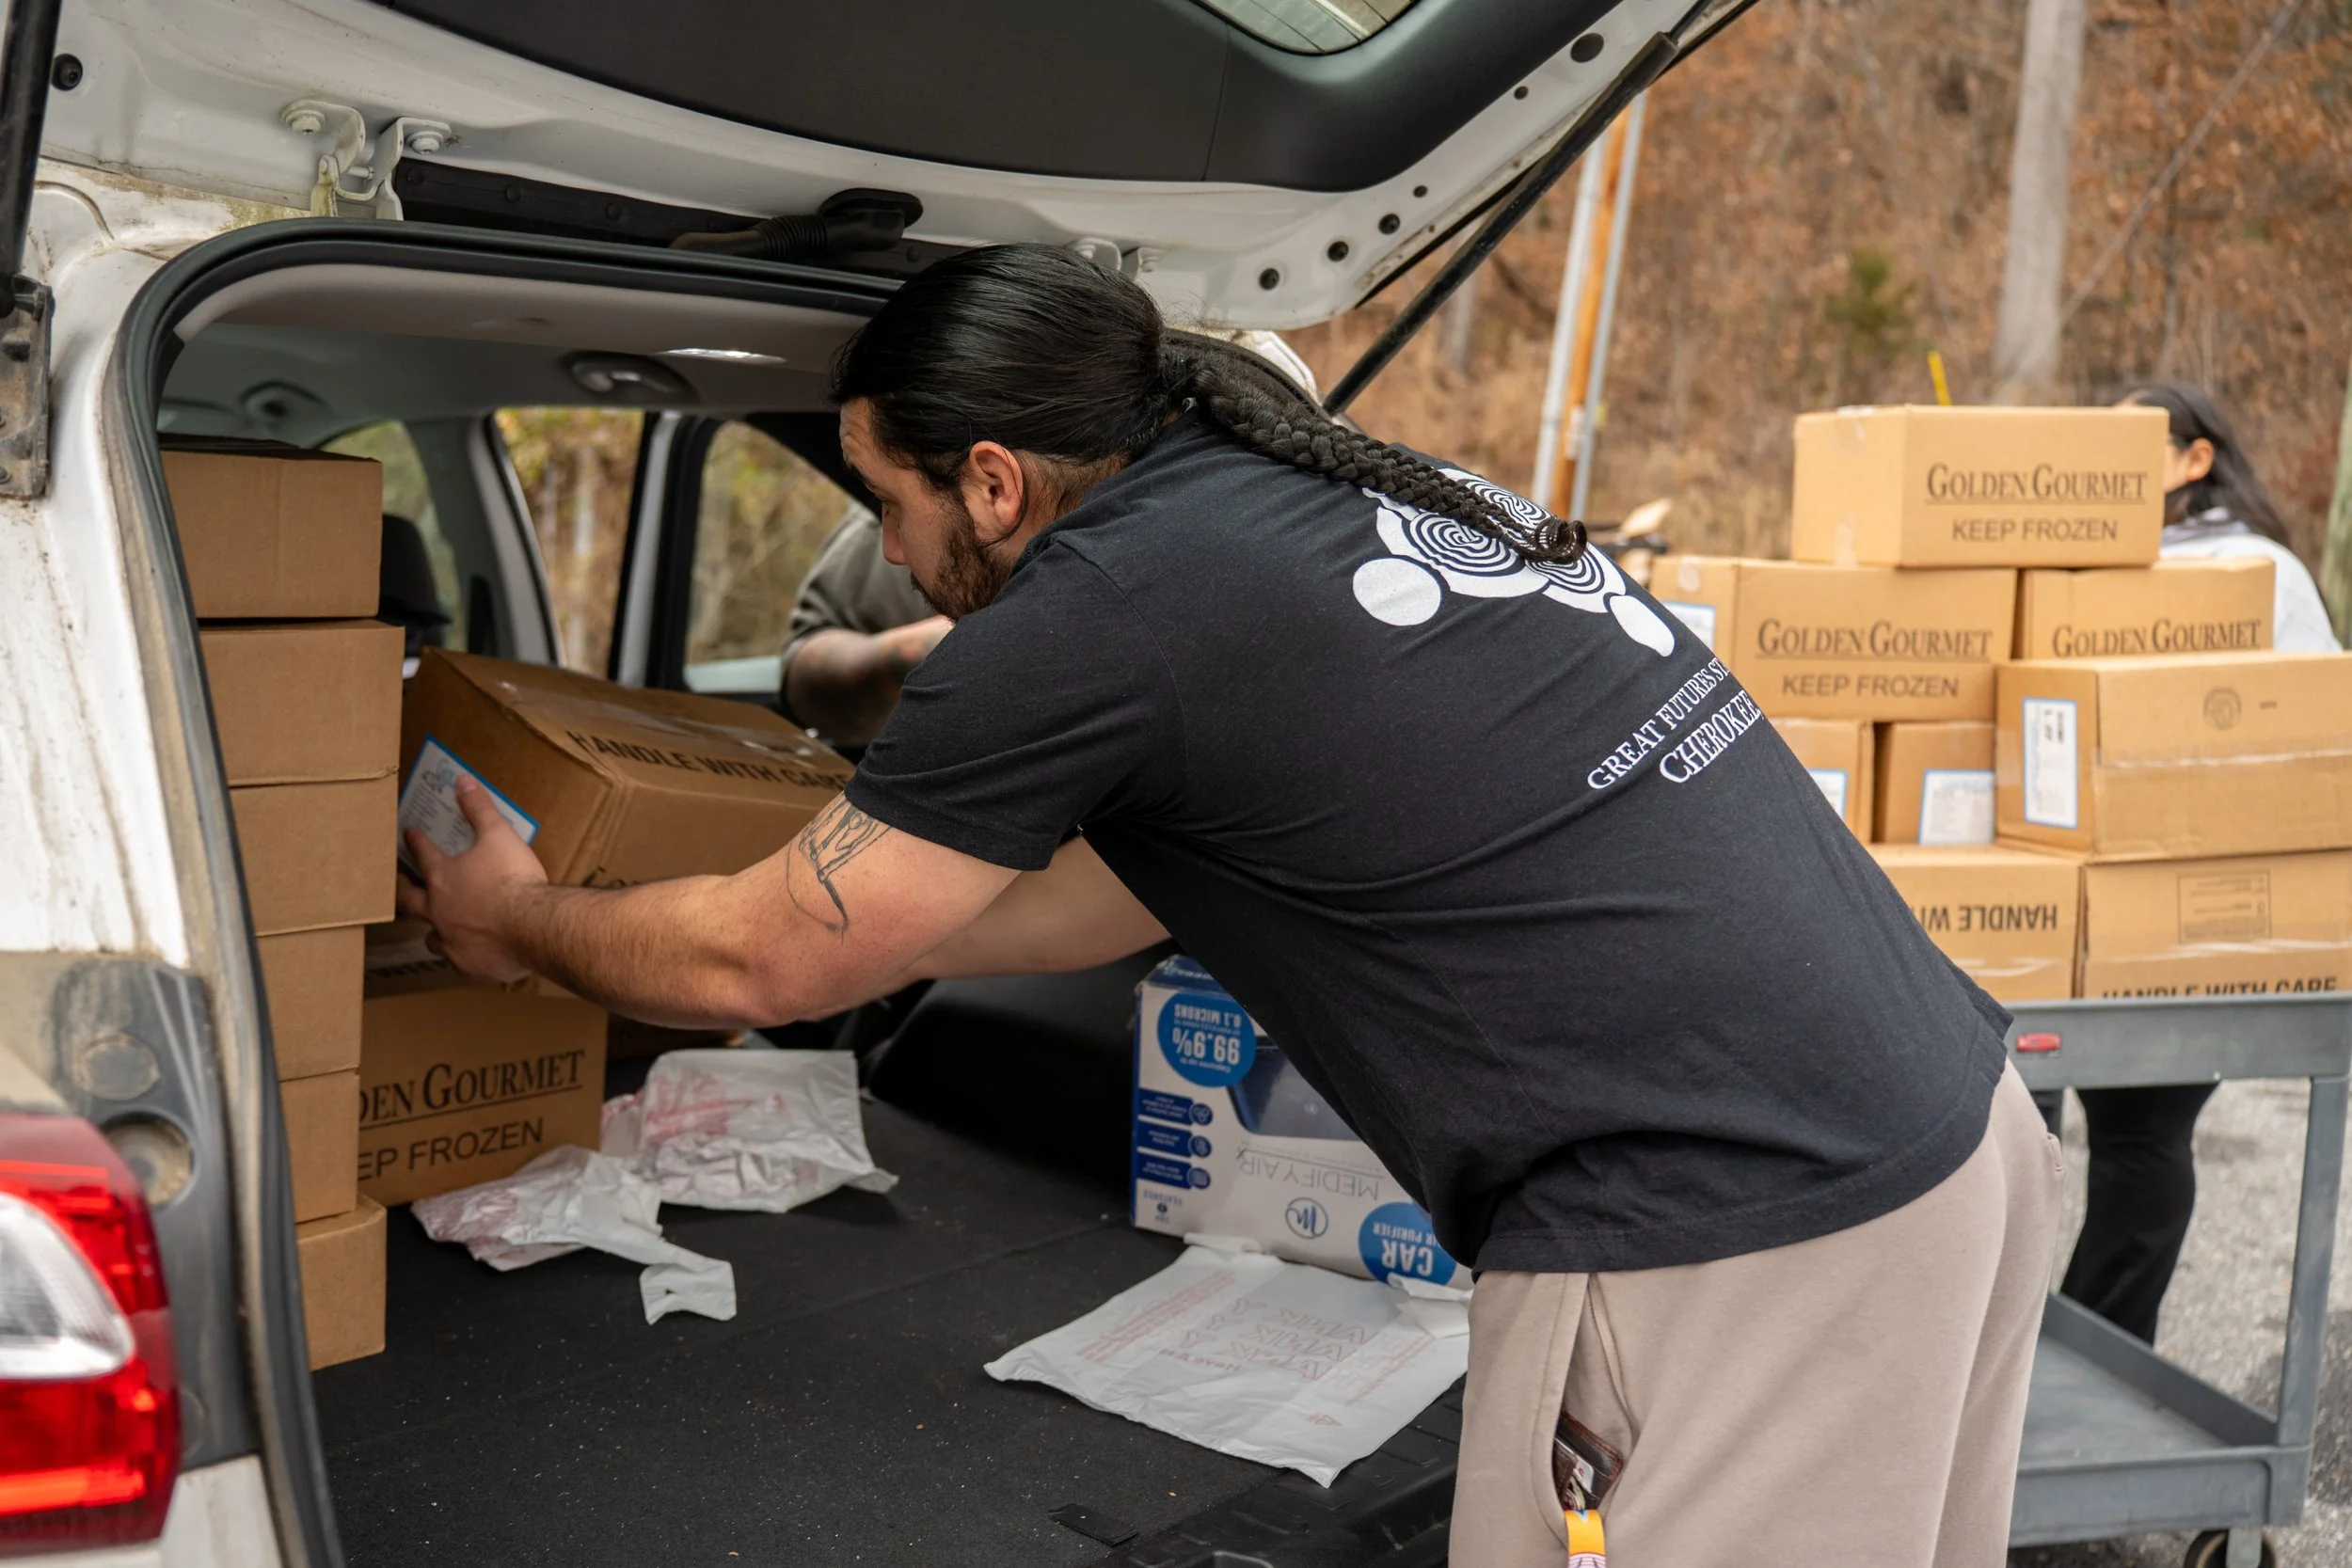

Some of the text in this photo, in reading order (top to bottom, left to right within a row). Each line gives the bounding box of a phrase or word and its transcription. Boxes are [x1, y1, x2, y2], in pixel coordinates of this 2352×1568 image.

[1927, 463, 2149, 501] GOLDEN GOURMET
[1952, 518, 2119, 542] KEEP FROZEN
[1756, 617, 1866, 657] GOLDEN
[1869, 618, 1994, 658] GOURMET
[2052, 617, 2262, 657] GOLDEN GOURMET
[1782, 673, 1960, 699] KEEP FROZEN
[1587, 719, 1665, 790] GREAT
[1655, 669, 1717, 730] FUTURES
[1659, 689, 1762, 784] CHEROKEE
[697, 755, 782, 784] WITH
[1921, 903, 2058, 932] HANDLE WI
[1174, 1003, 1221, 1025] MICRONS
[1171, 1026, 1241, 1066] 99.9%
[421, 1048, 586, 1111] GOURMET
[358, 1117, 544, 1181] EP FROZEN
[1281, 1163, 1379, 1201] MEDIFY
[1373, 1221, 1439, 1246] IR PURIFIER
[1380, 1238, 1434, 1277] CAR
